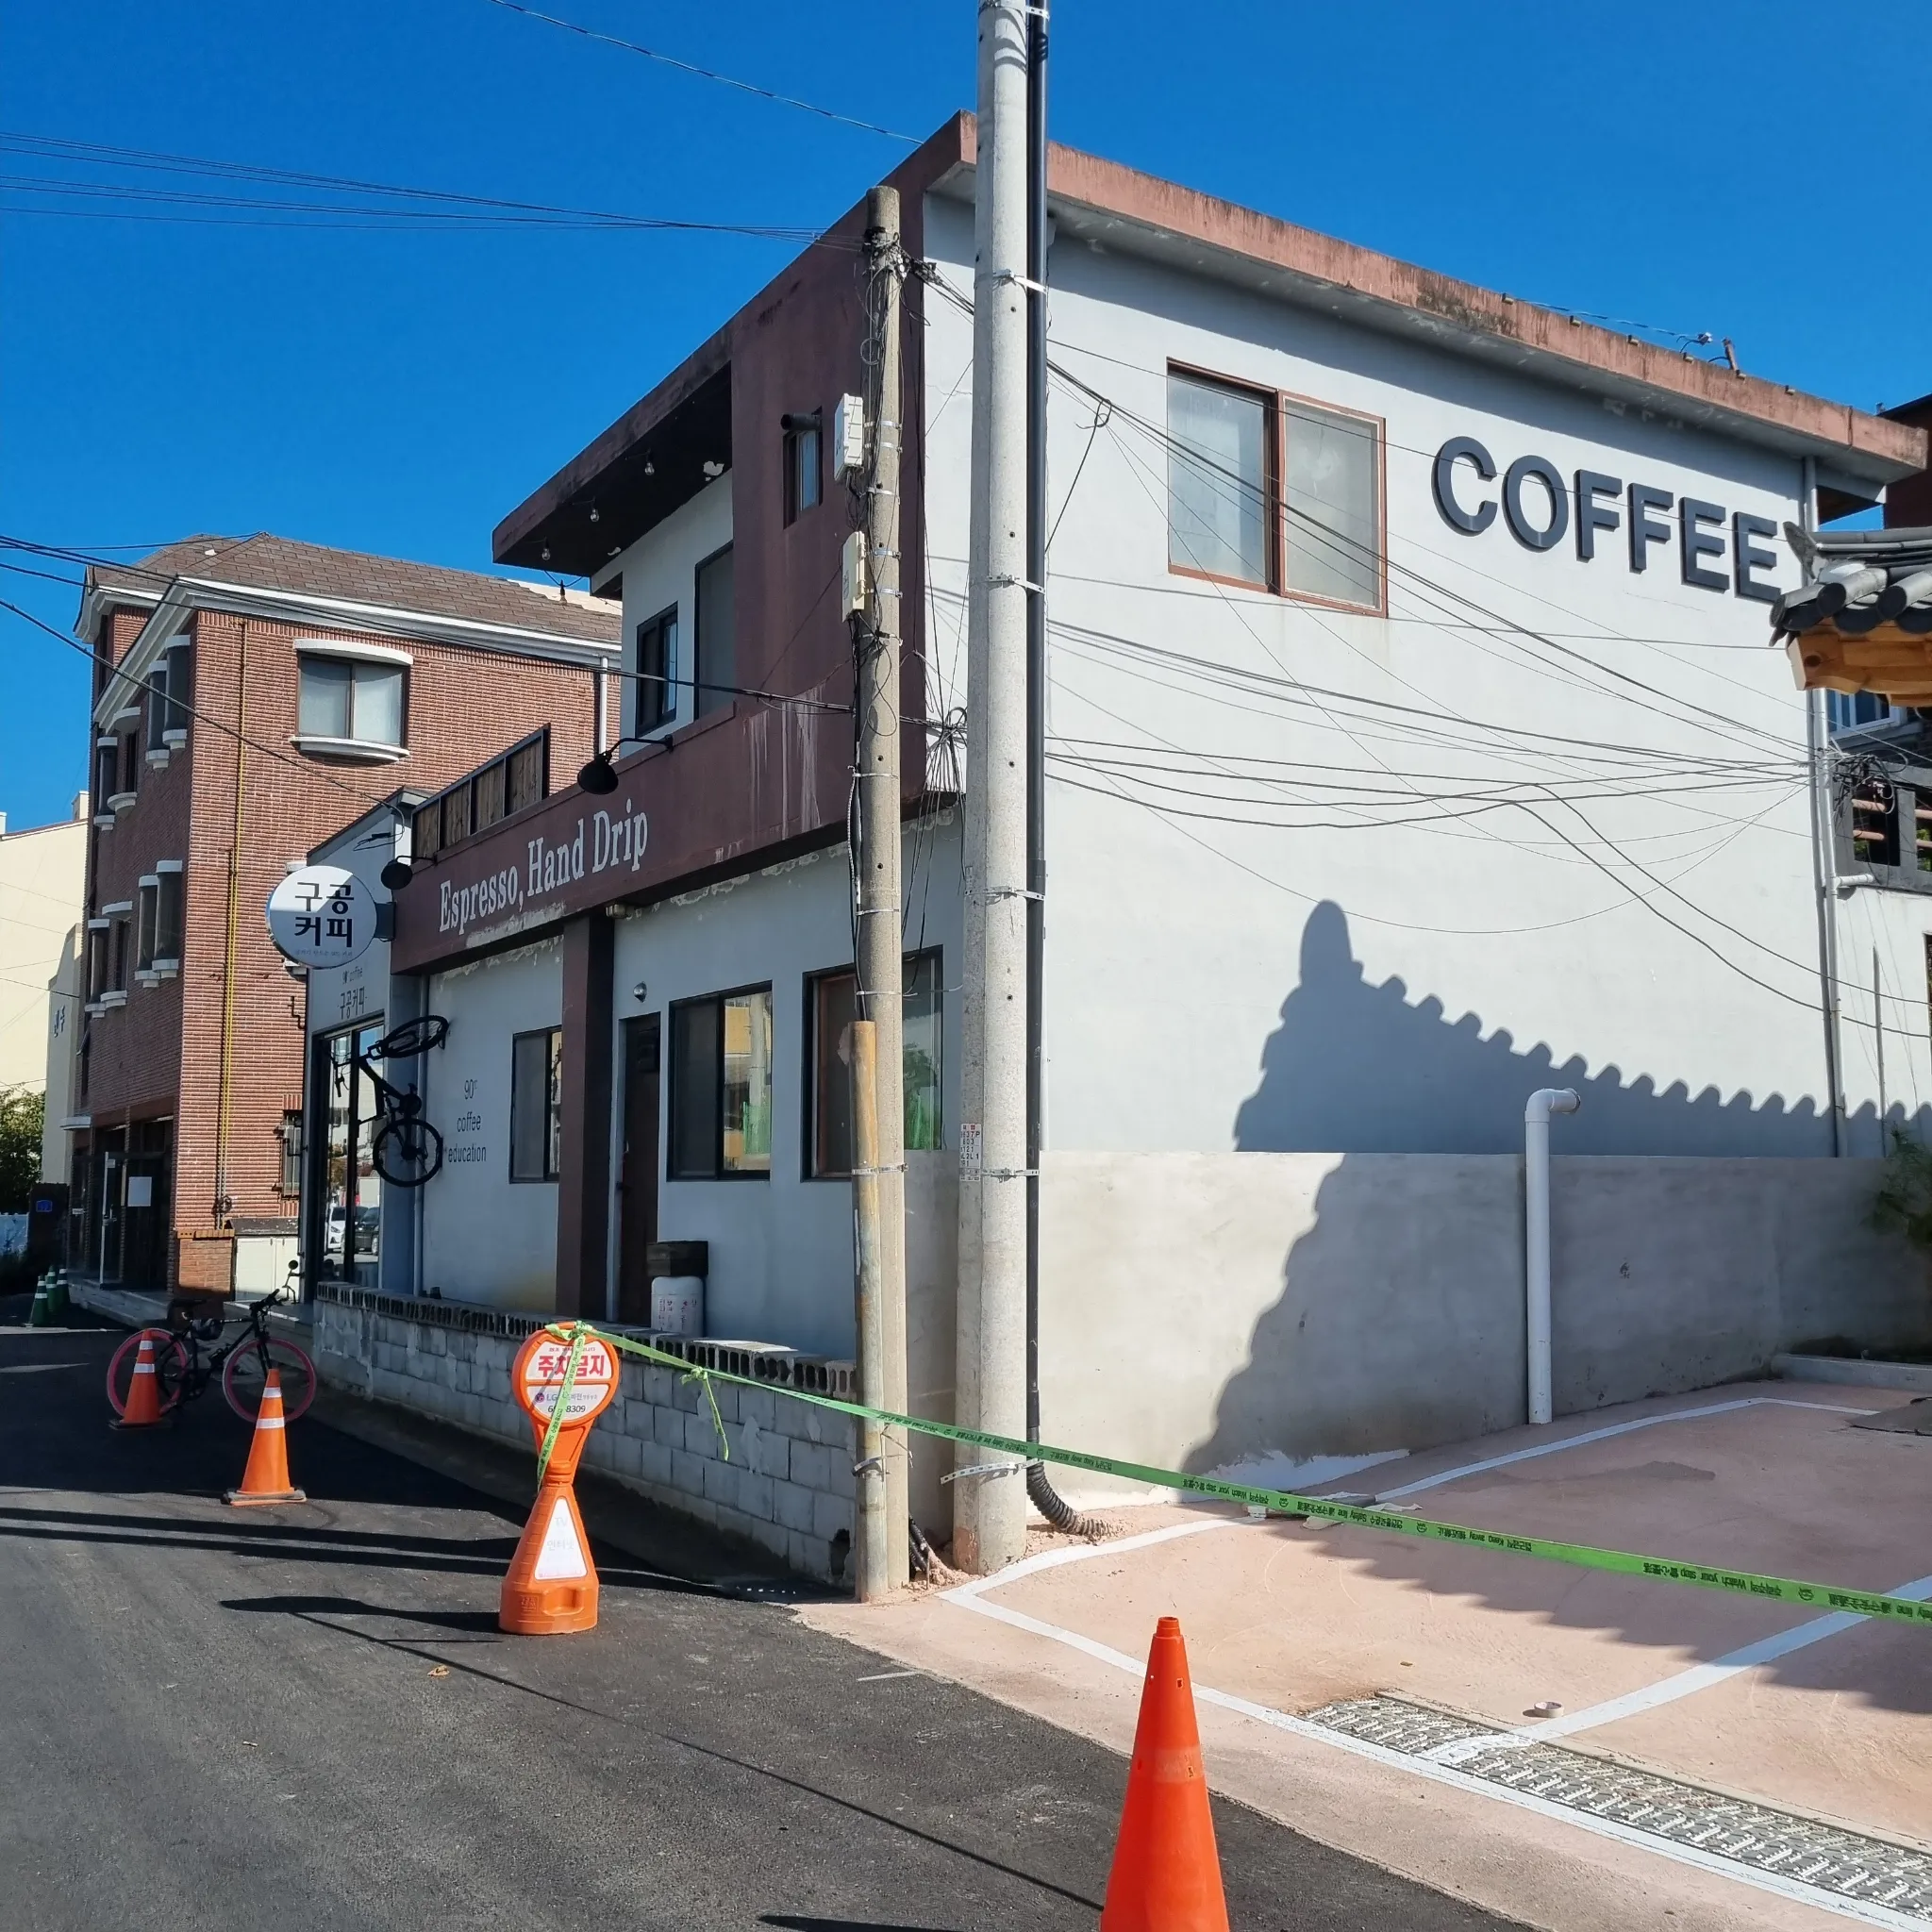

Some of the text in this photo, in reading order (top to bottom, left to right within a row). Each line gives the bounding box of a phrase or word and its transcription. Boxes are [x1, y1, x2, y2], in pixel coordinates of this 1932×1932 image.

[1431, 436, 1781, 604] COFFEE
[439, 798, 648, 936] Espresso, Hand Drip
[294, 882, 355, 915] 구공
[294, 916, 354, 947] 커피
[457, 1111, 482, 1132] coffee
[447, 1142, 487, 1163] education
